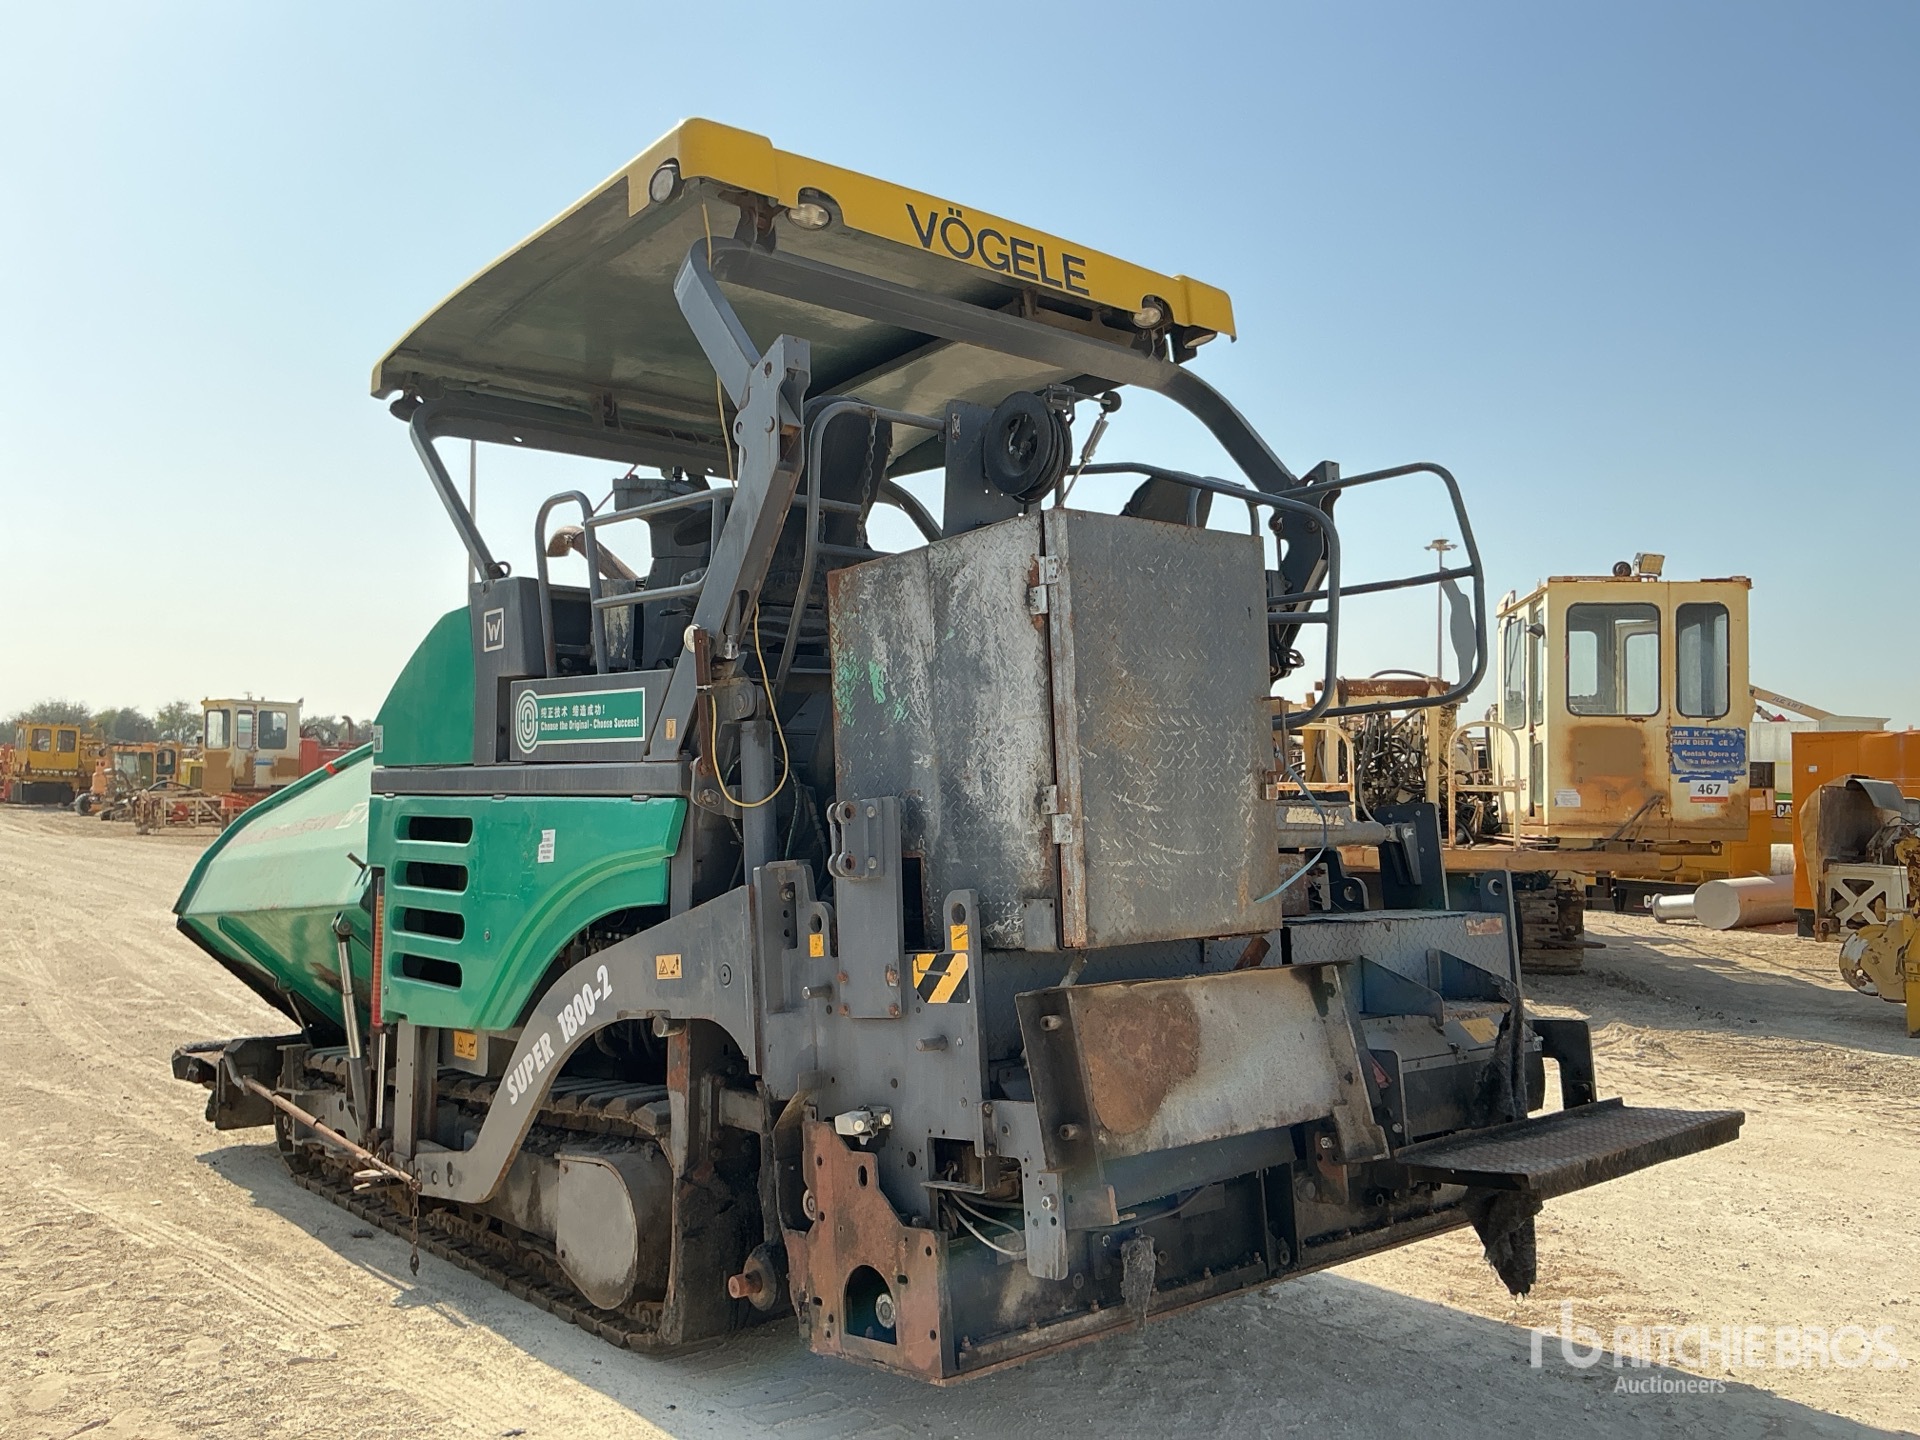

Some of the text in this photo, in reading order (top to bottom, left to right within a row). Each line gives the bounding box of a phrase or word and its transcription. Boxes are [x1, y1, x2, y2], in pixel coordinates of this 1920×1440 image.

[905, 204, 1090, 296] VÖGELE
[541, 721, 558, 731] Choose
[560, 720, 568, 730] the
[569, 719, 589, 731] Original
[593, 718, 612, 729] Choose
[614, 716, 639, 728] Success!
[1697, 783, 1721, 795] 467
[506, 965, 613, 1105] SUPER 1800-2
